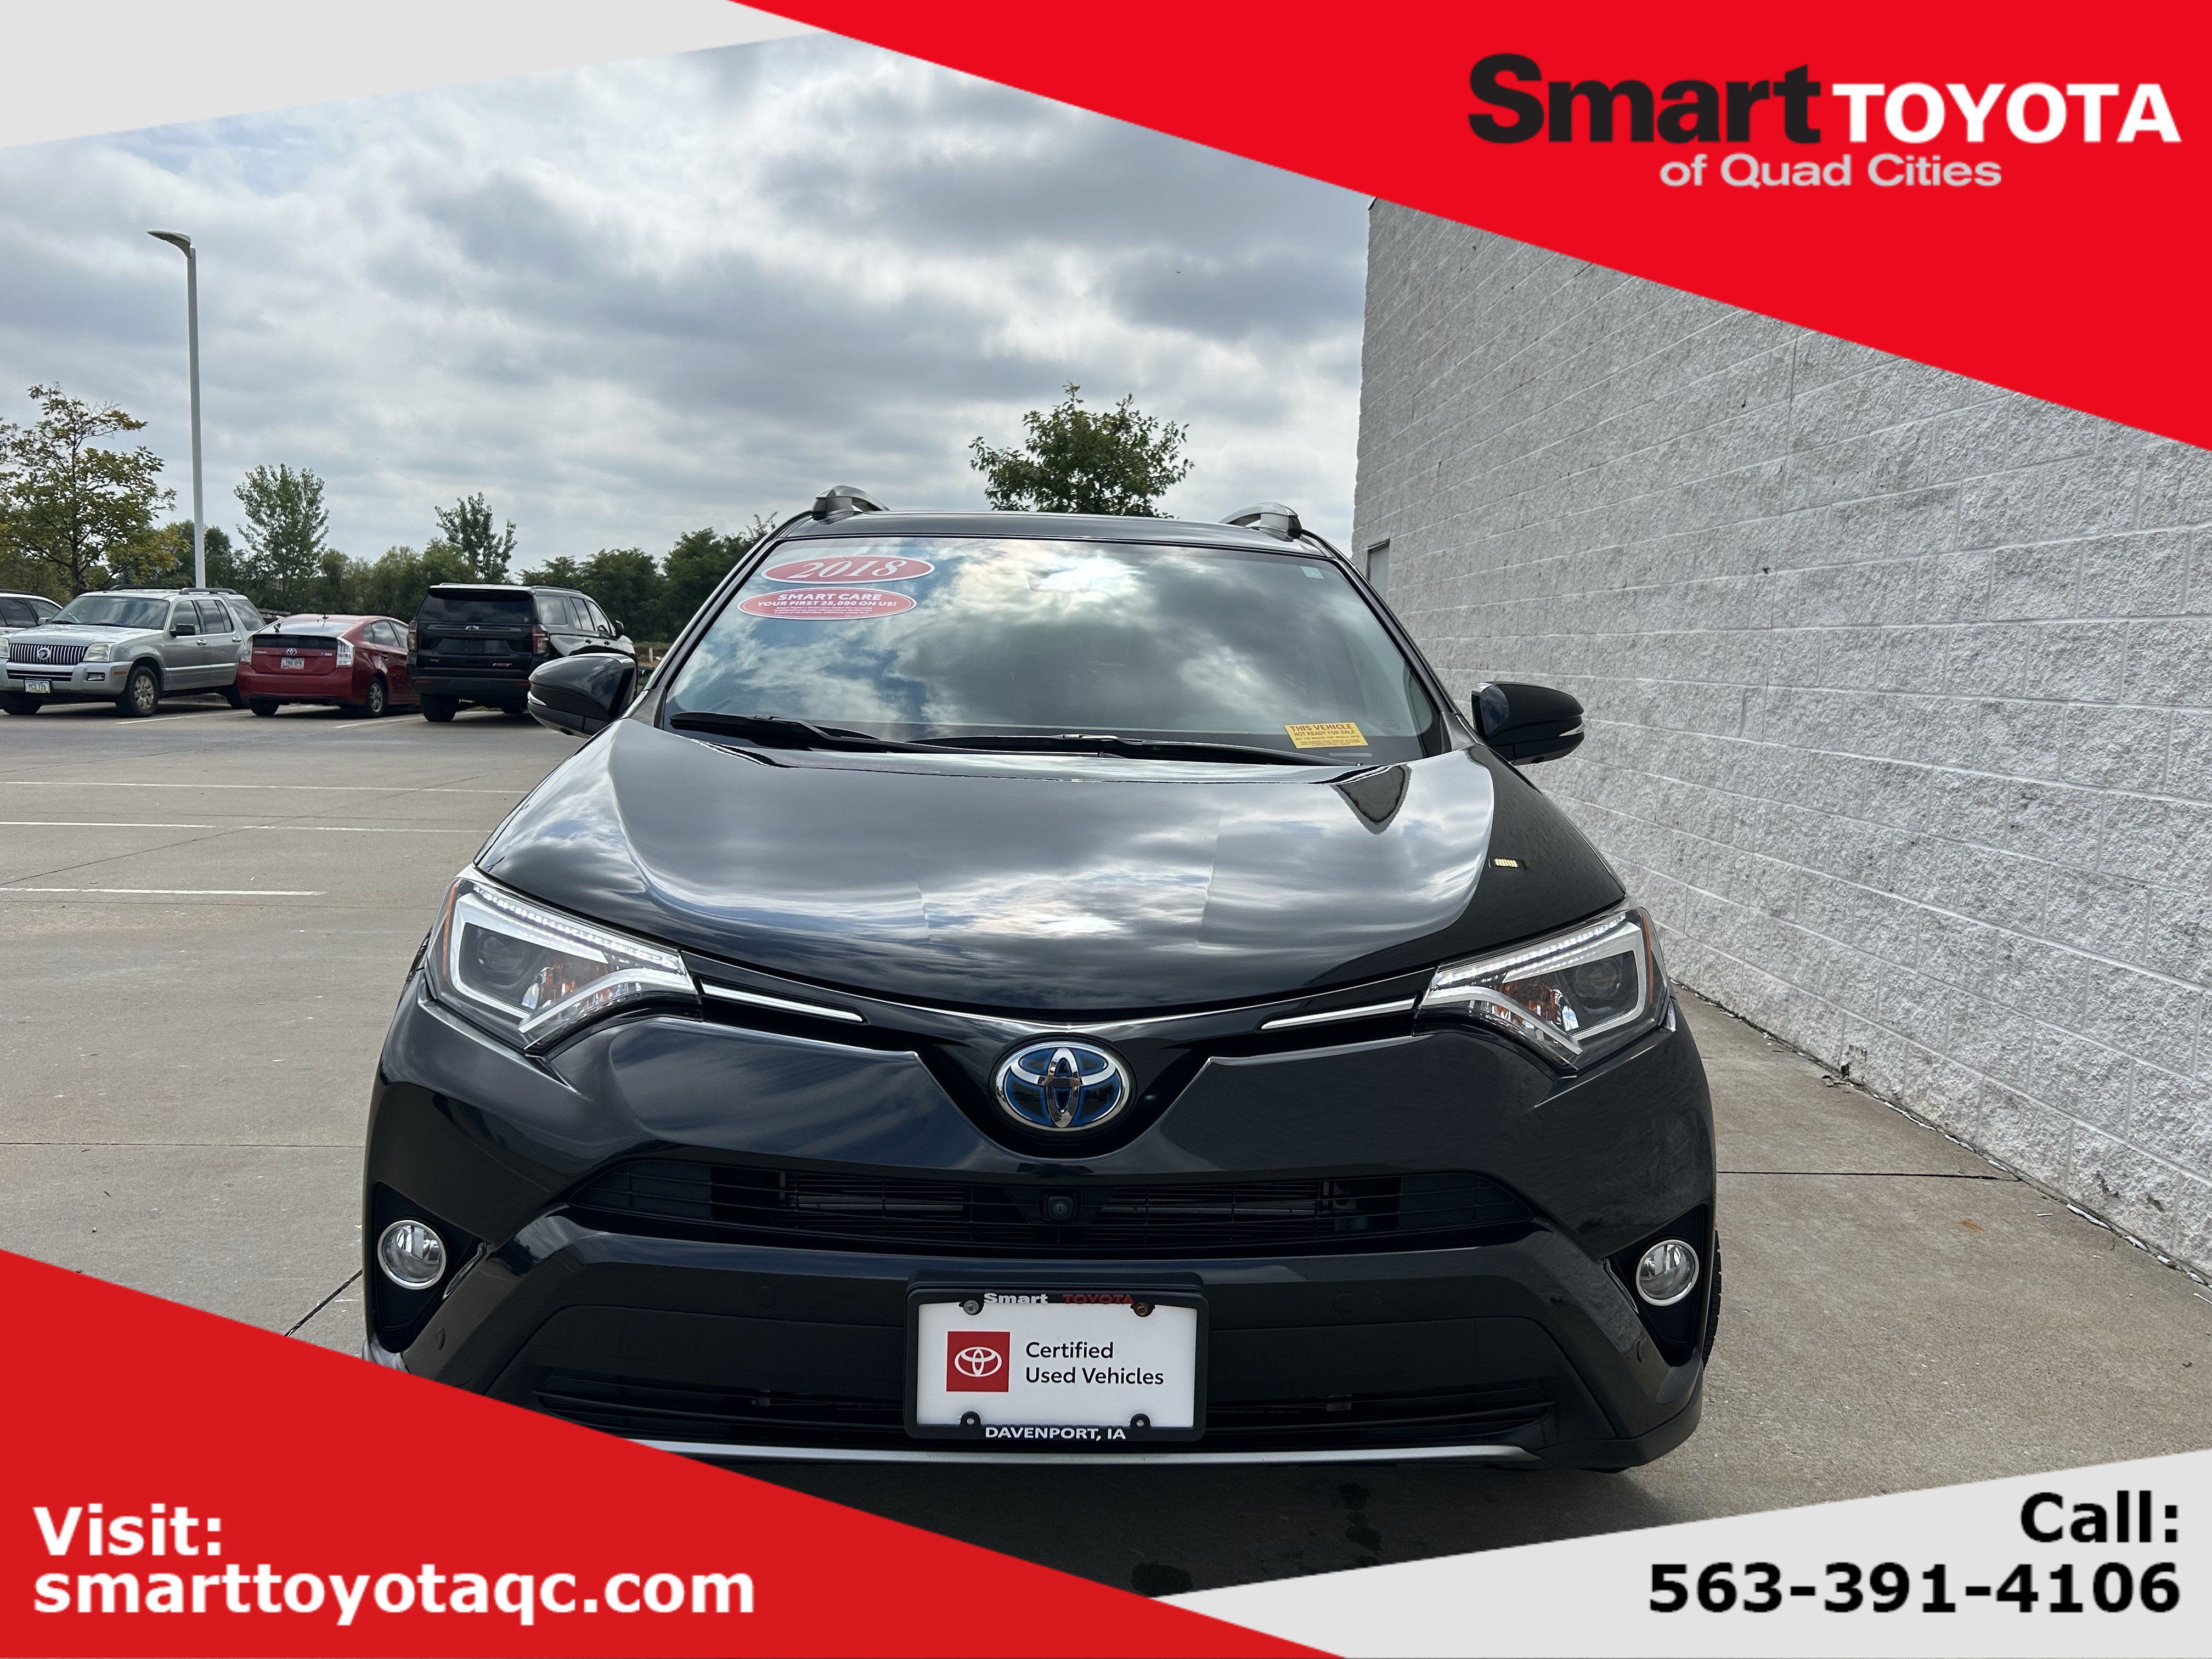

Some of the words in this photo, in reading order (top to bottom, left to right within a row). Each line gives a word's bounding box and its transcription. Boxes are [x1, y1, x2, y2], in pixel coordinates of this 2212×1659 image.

[786, 560, 907, 579] 2018
[984, 1293, 1048, 1305] Smart
[1063, 1294, 1135, 1305] TOYOTA
[1026, 1341, 1114, 1359] Certified
[1026, 1366, 1076, 1384] Used
[1081, 1367, 1164, 1385] Vehicles
[985, 1427, 1102, 1441] DAVENPORT,
[1107, 1427, 1126, 1440] IA
